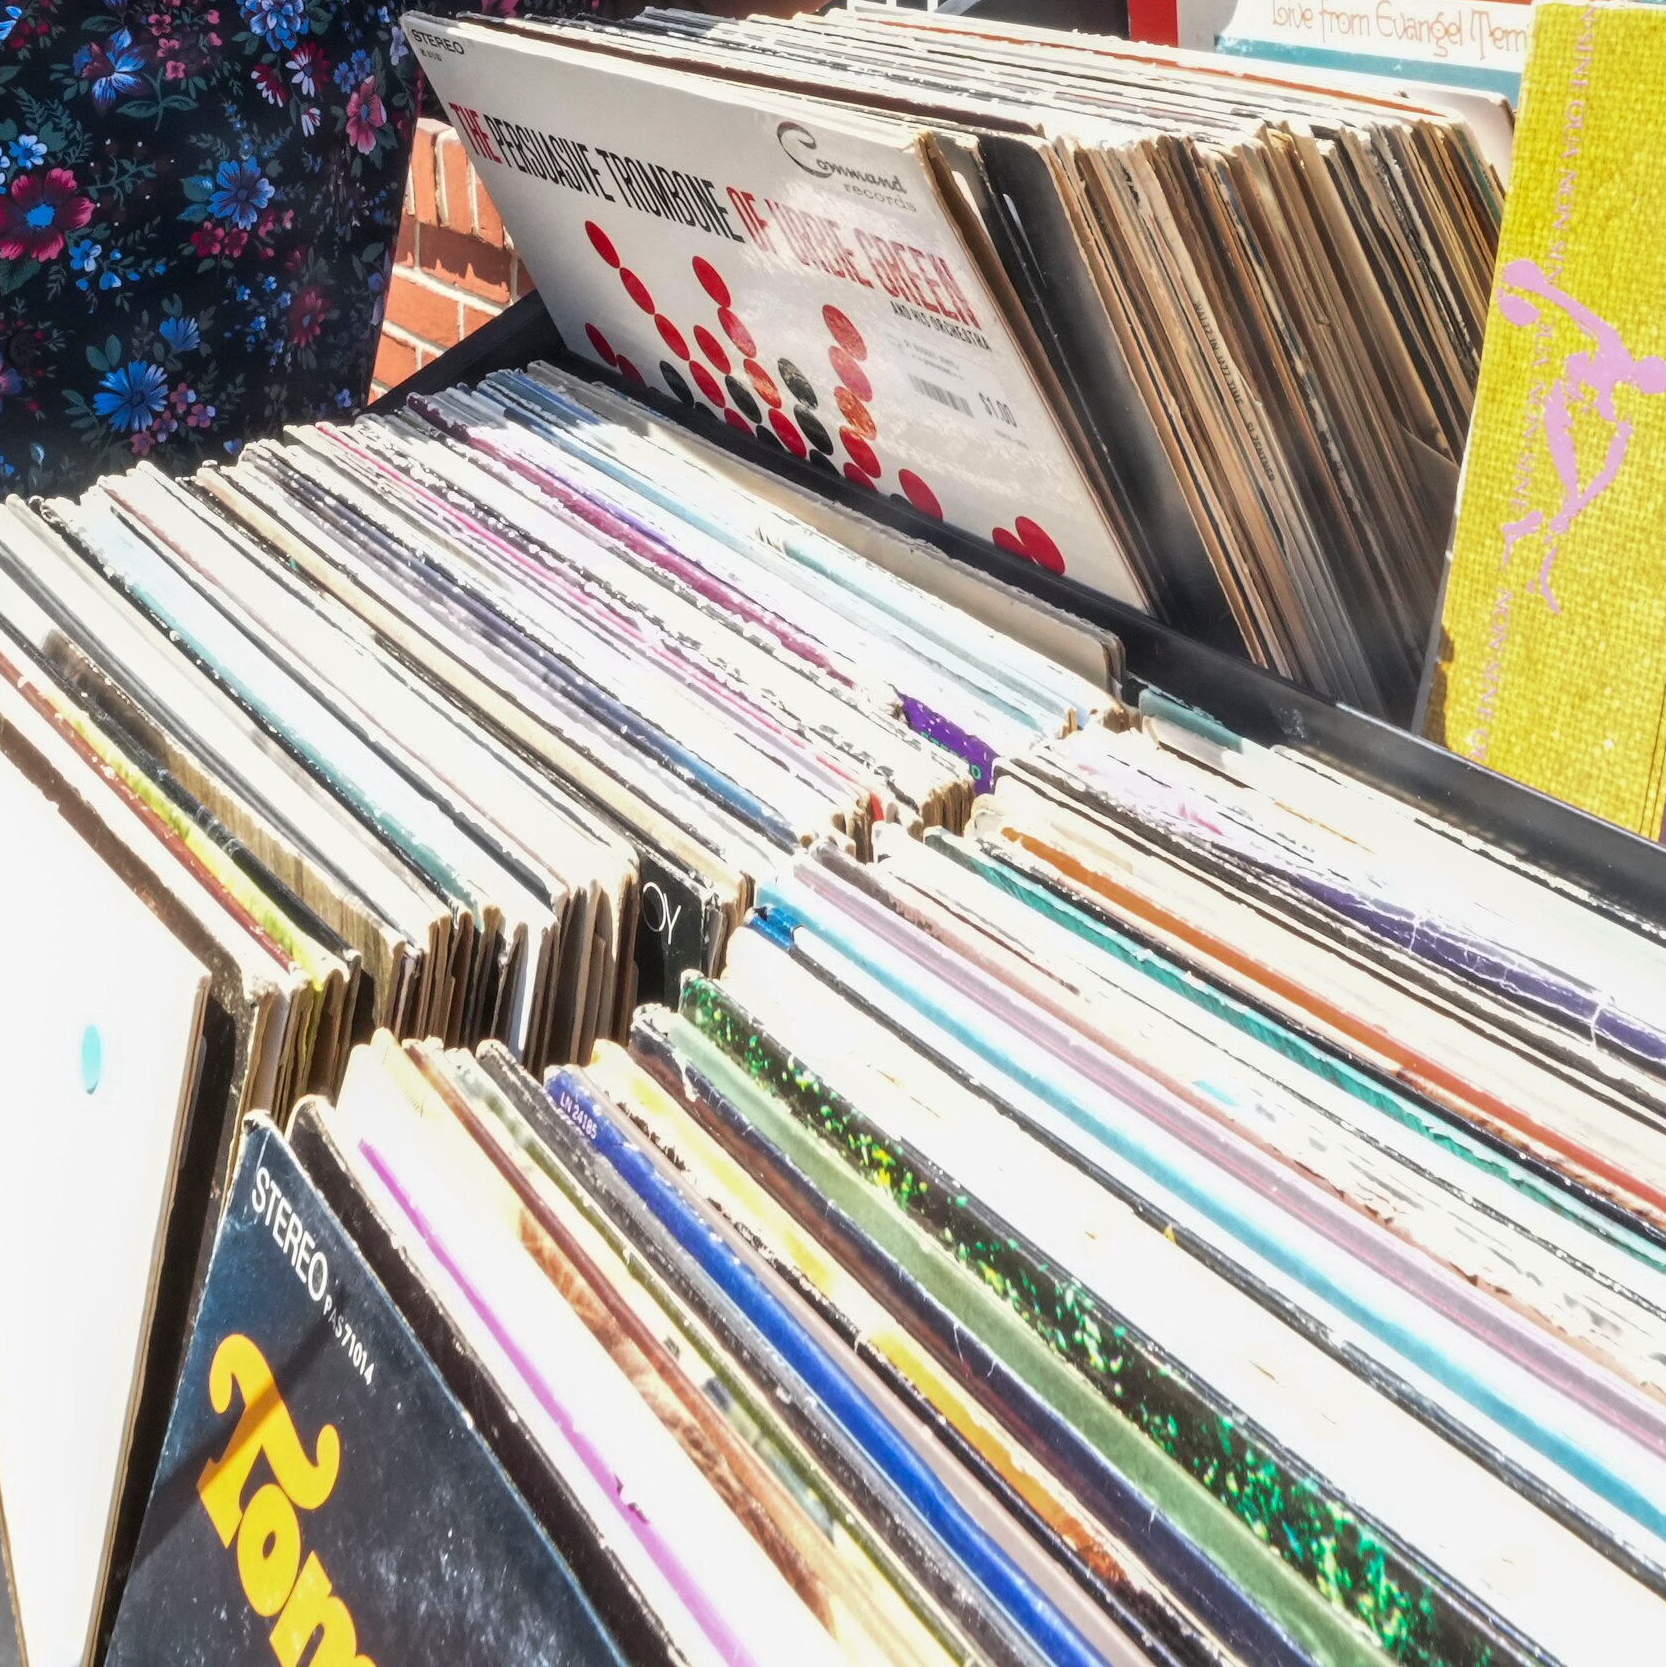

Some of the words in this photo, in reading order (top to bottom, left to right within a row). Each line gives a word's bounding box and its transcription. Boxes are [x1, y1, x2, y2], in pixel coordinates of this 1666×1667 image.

[411, 29, 465, 55] STEREO
[1375, 0, 1463, 58] Evangel
[1471, 8, 1530, 62] Tem
[776, 120, 908, 195] Command
[448, 102, 503, 165] THE
[482, 113, 617, 204] PERSUASIVE
[594, 146, 746, 244] TROMBONE
[726, 186, 778, 256] OF
[853, 227, 982, 331] GREEN
[844, 183, 917, 213] records
[890, 300, 913, 321] AND
[909, 308, 932, 329] HIS
[929, 315, 993, 352] ORCHESTRA
[1209, 337, 1220, 353] IN
[1216, 352, 1232, 380] JAZZ
[1227, 378, 1244, 407] TIME
[978, 391, 1019, 428] $1.00
[560, 1091, 573, 1114] LN
[571, 1103, 598, 1140] 24185
[250, 1166, 330, 1302] STEREO
